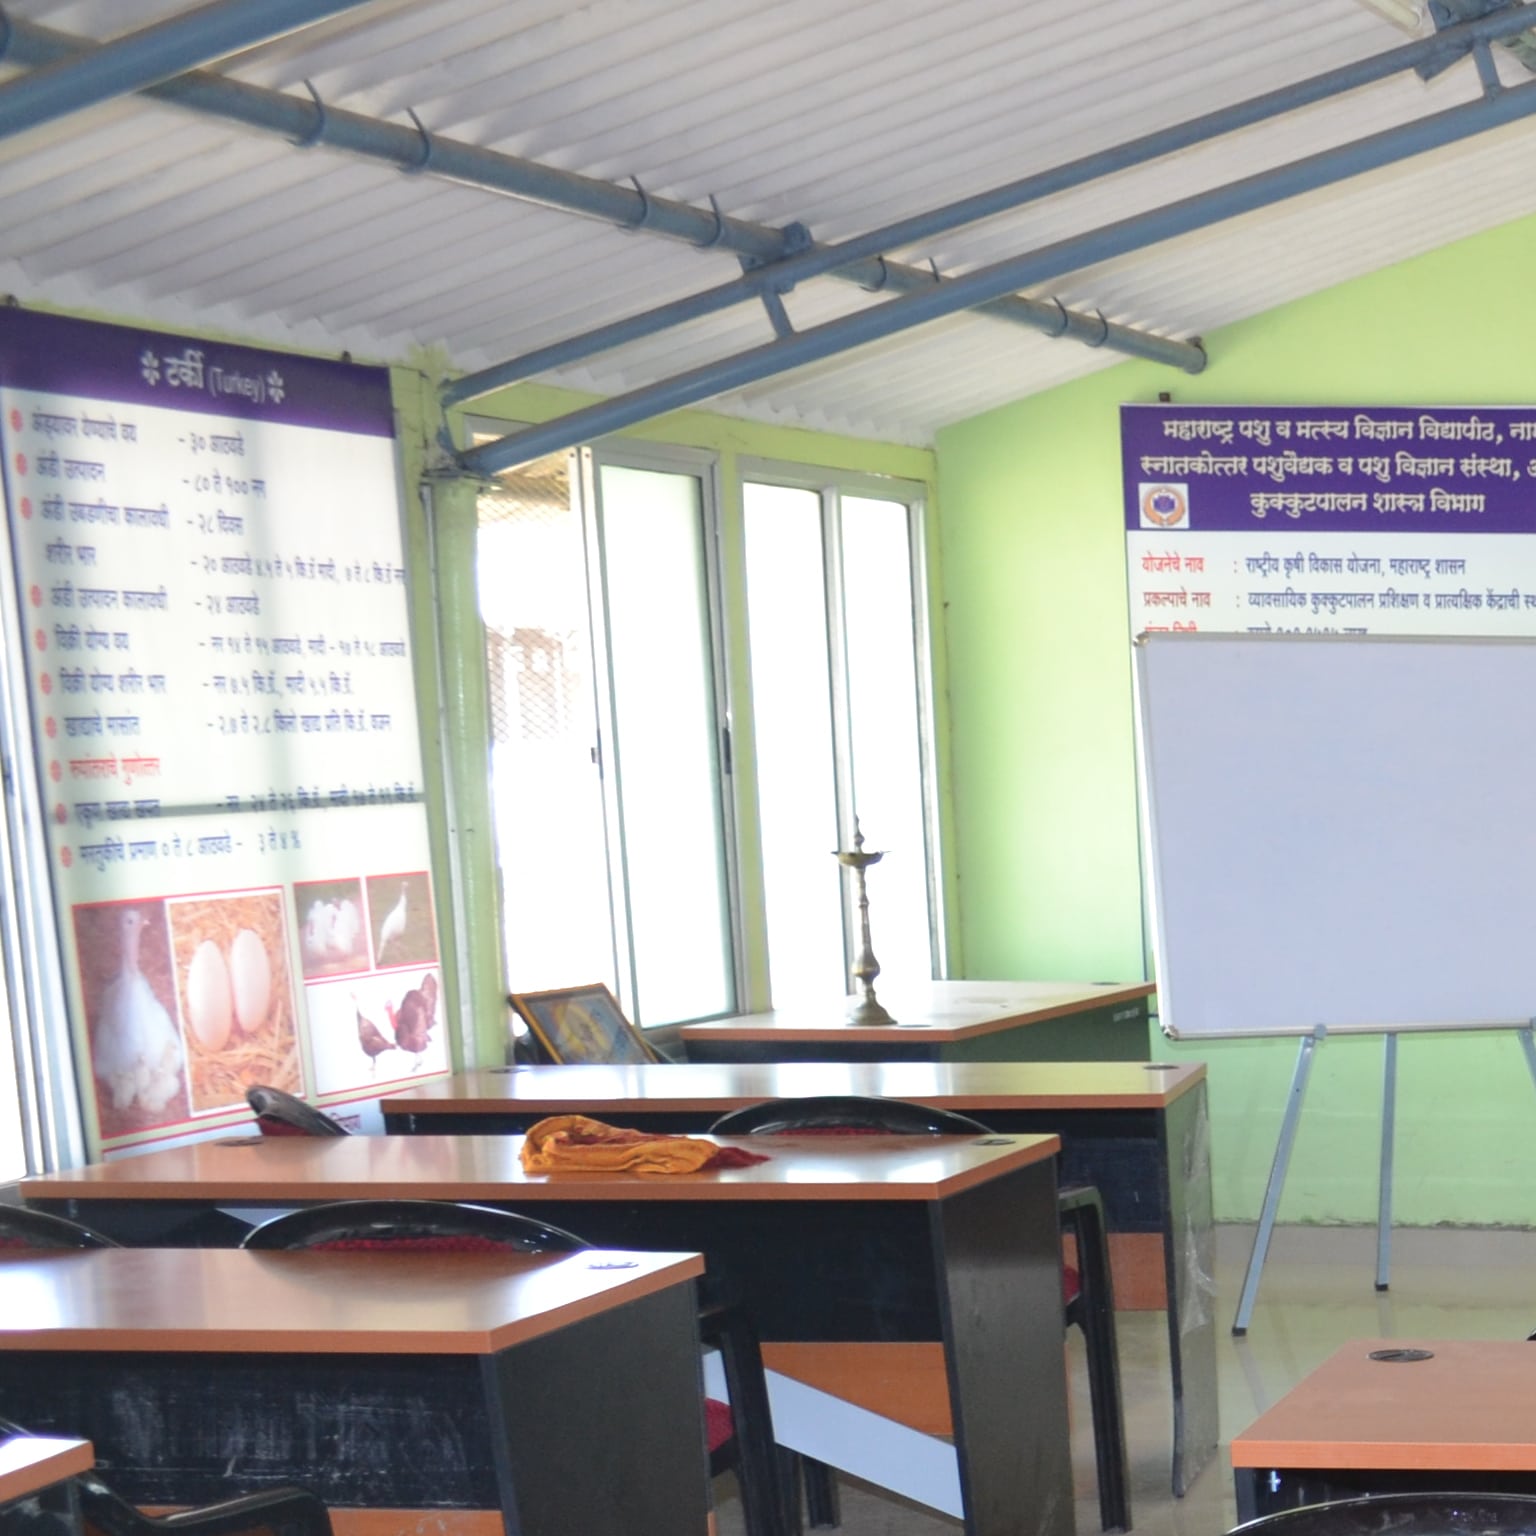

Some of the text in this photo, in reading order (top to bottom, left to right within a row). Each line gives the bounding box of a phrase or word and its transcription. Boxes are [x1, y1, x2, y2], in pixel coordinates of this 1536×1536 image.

[165, 349, 266, 404] टर्की (Turkey)
[1163, 419, 1233, 444] महाराष्ट्र
[1238, 419, 1271, 447] पशु
[1276, 420, 1291, 439] व
[1296, 420, 1349, 441] मत्स्य
[1354, 414, 1414, 442] विज्ञान
[1140, 450, 1248, 476] स्नातकोत्तर
[1252, 450, 1333, 483] पशुवैद्यक
[1338, 456, 1354, 476] व
[1358, 456, 1391, 483] पशु
[1395, 451, 1455, 479] विज्ञान
[1250, 487, 1485, 519] कुक्कुटपालन शास्त्र विभाग
[1142, 551, 1181, 572] योजनेचे
[1185, 557, 1205, 573] नाव
